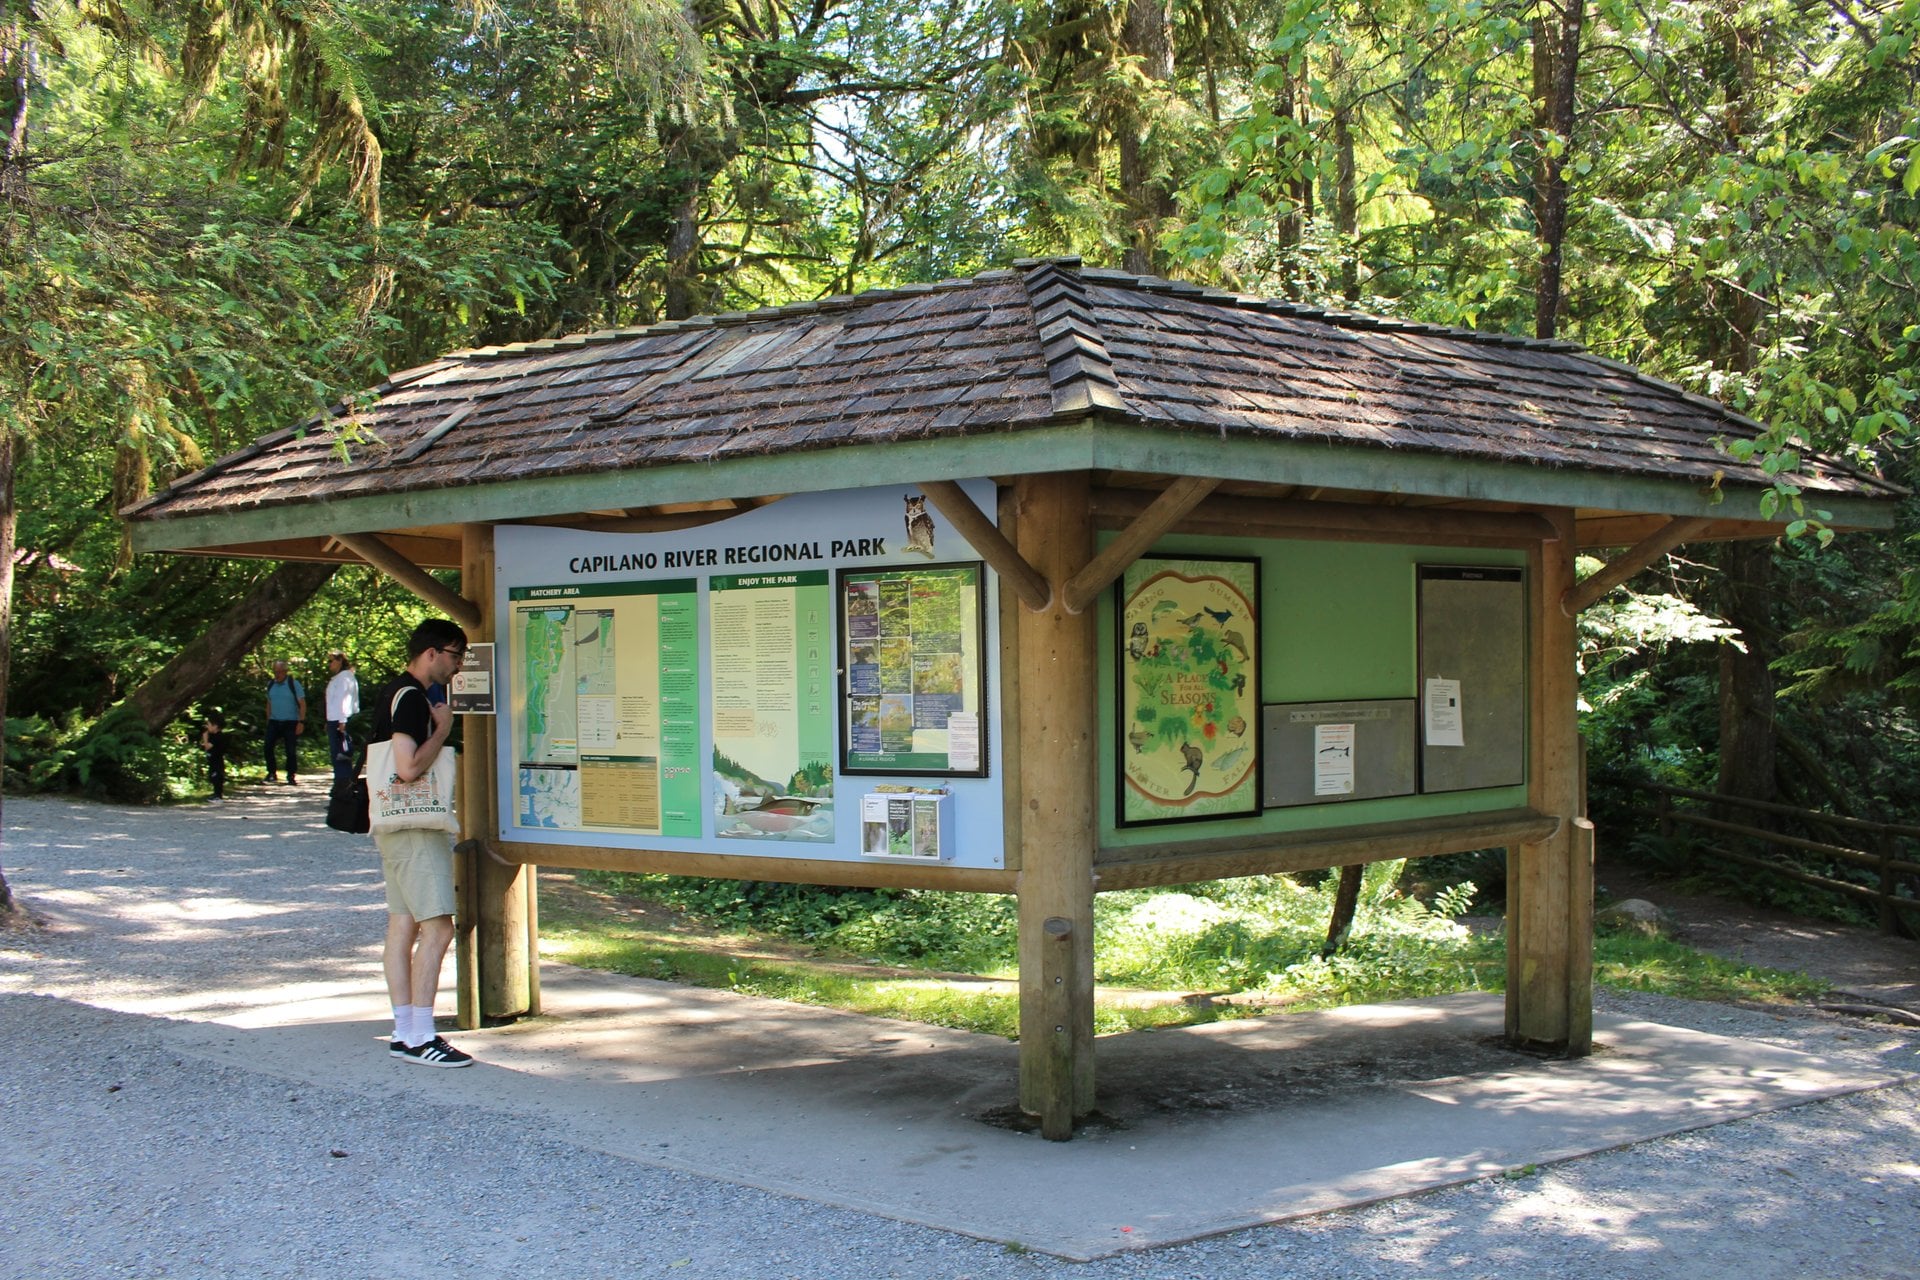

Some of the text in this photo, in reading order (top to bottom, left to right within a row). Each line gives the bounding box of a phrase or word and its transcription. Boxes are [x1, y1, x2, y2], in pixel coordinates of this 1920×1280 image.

[569, 537, 886, 574] CAPILANO RIVER REGIONAL PARK
[738, 575, 798, 587] ENJOY THE PARK
[530, 587, 580, 597] HATCHERY AREA
[464, 651, 476, 659] Fire
[1164, 672, 1208, 684] A PLACE
[1161, 690, 1217, 705] SEASONS
[1222, 761, 1247, 785] FALL
[381, 806, 447, 818] LUCKY RECORDS
